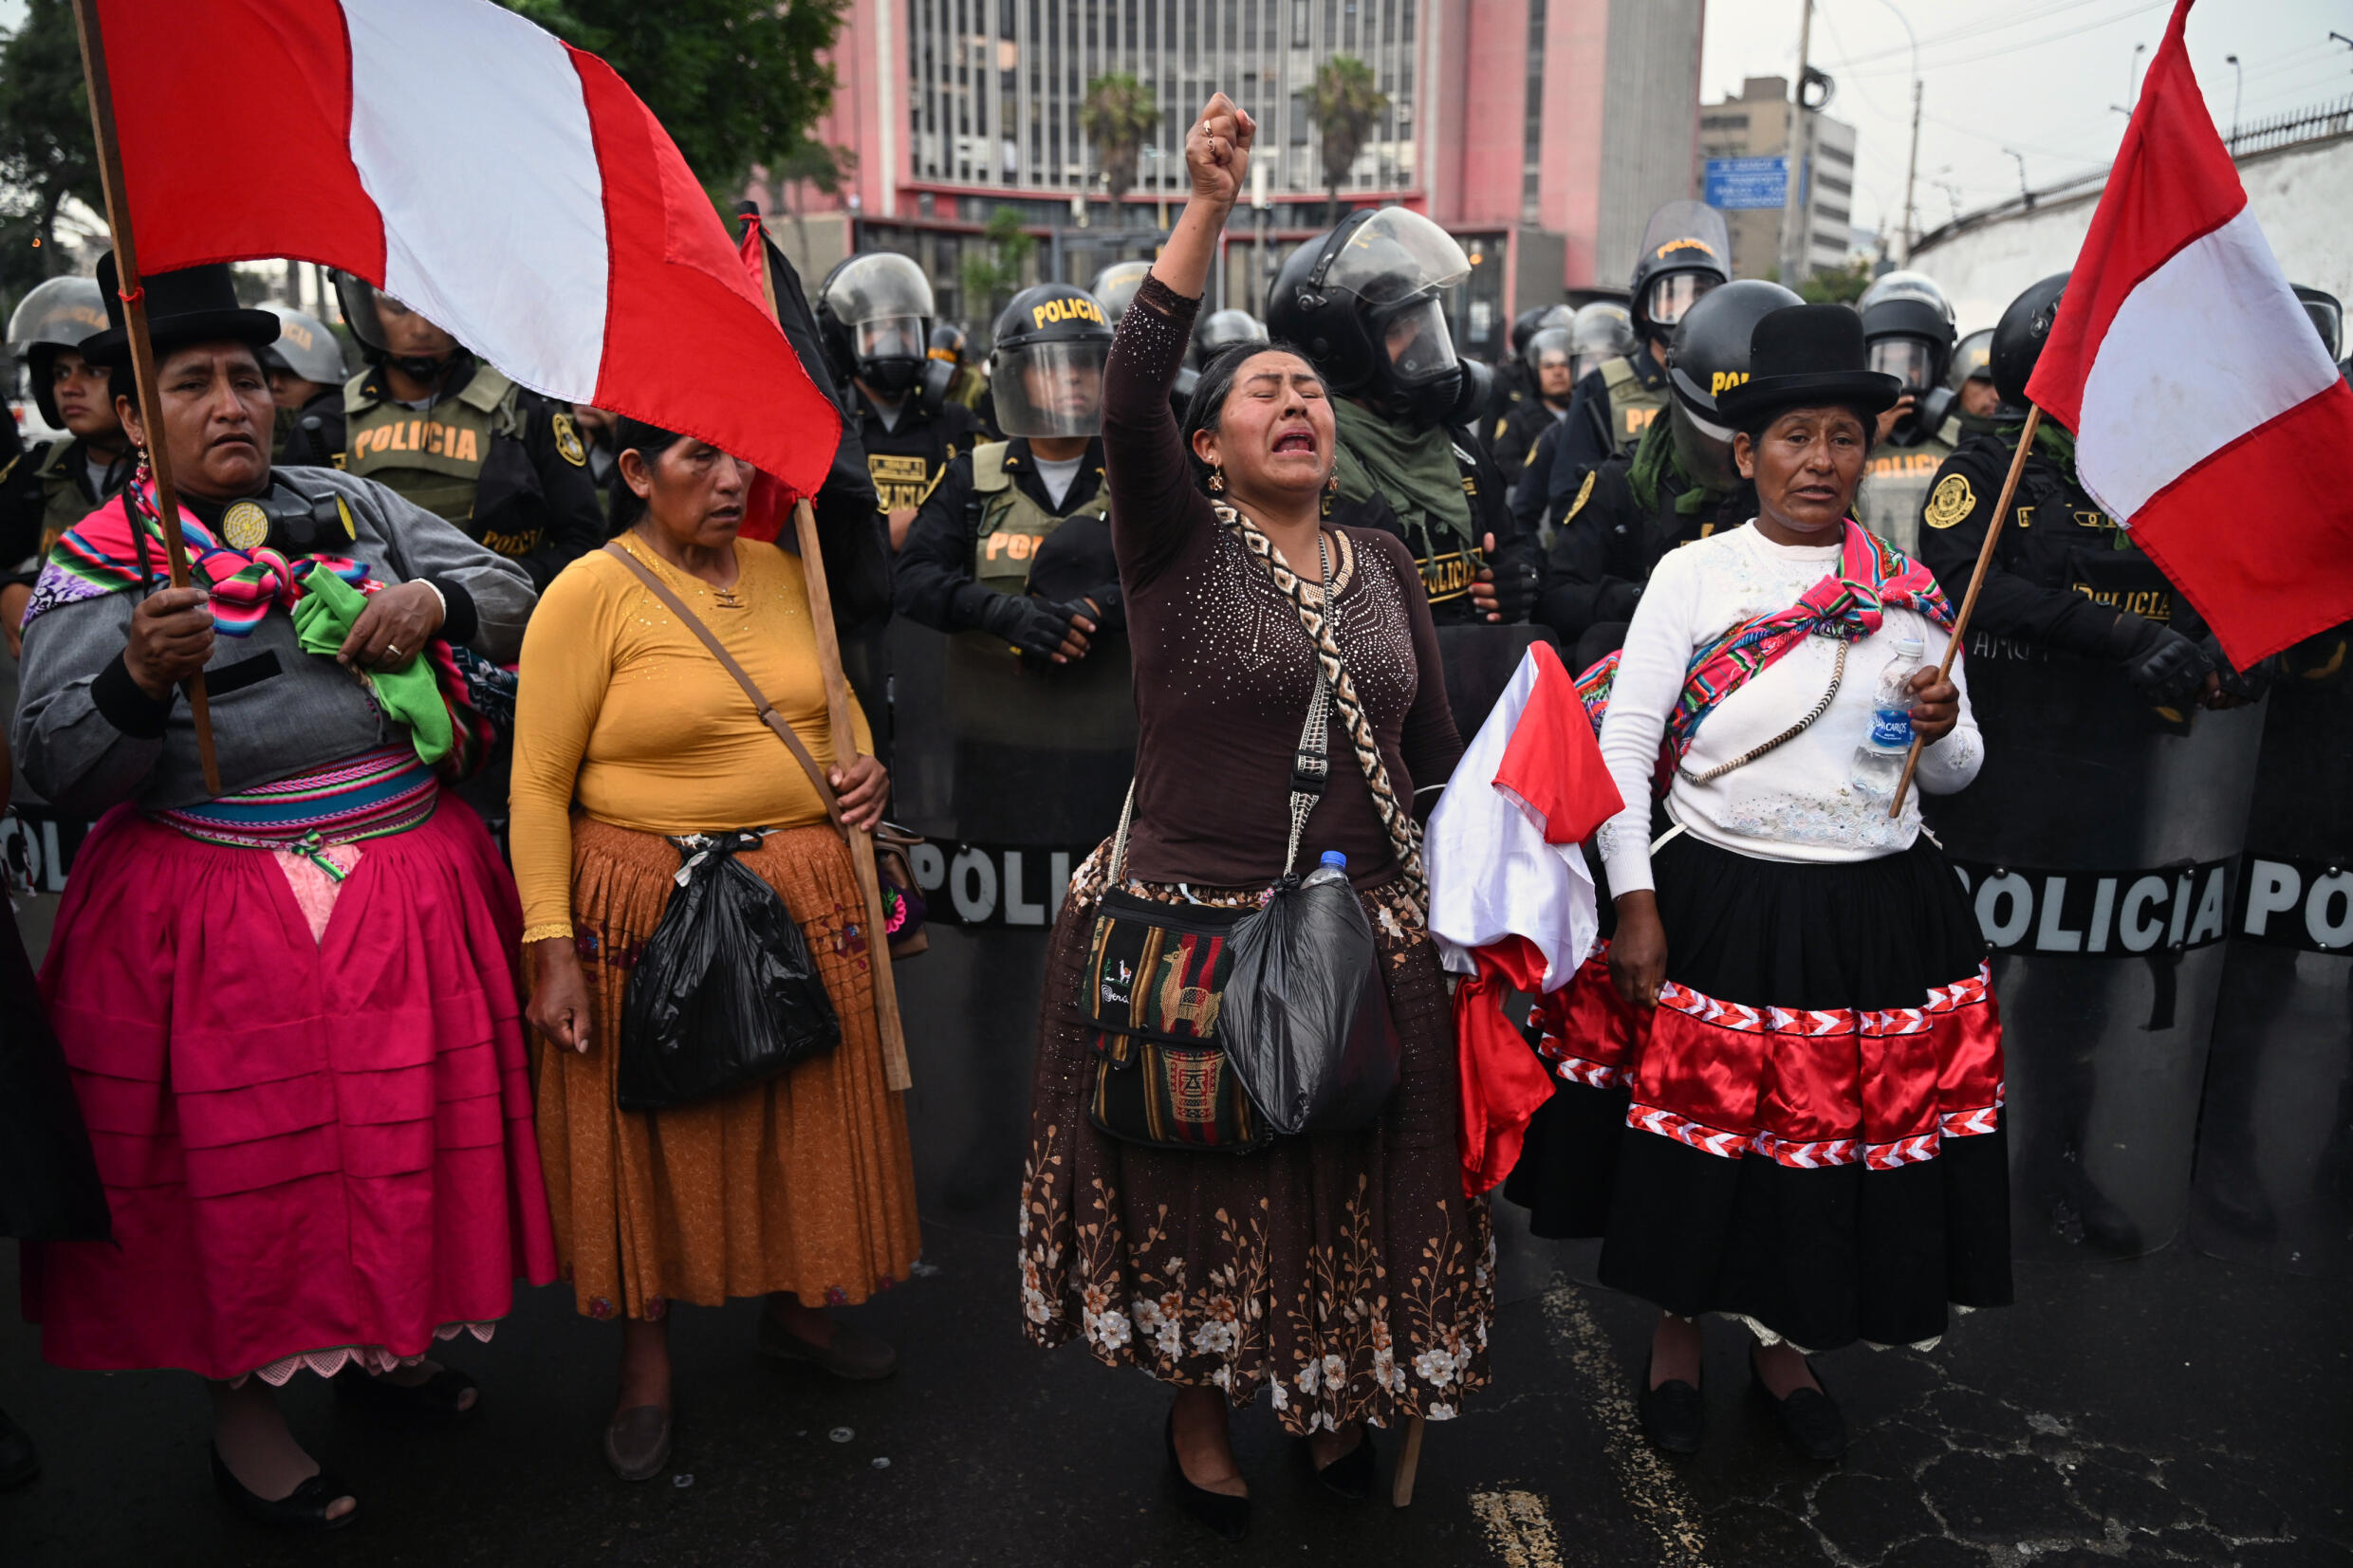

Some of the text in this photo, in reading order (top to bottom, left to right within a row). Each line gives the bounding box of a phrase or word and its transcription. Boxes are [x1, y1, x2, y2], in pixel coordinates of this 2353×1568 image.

[1032, 298, 1104, 329] POLICIA
[355, 420, 478, 462] POLICIA
[1417, 561, 1476, 594] OLICIA
[1886, 723, 1907, 734] CARLOS
[1953, 865, 2224, 952] OLICIA
